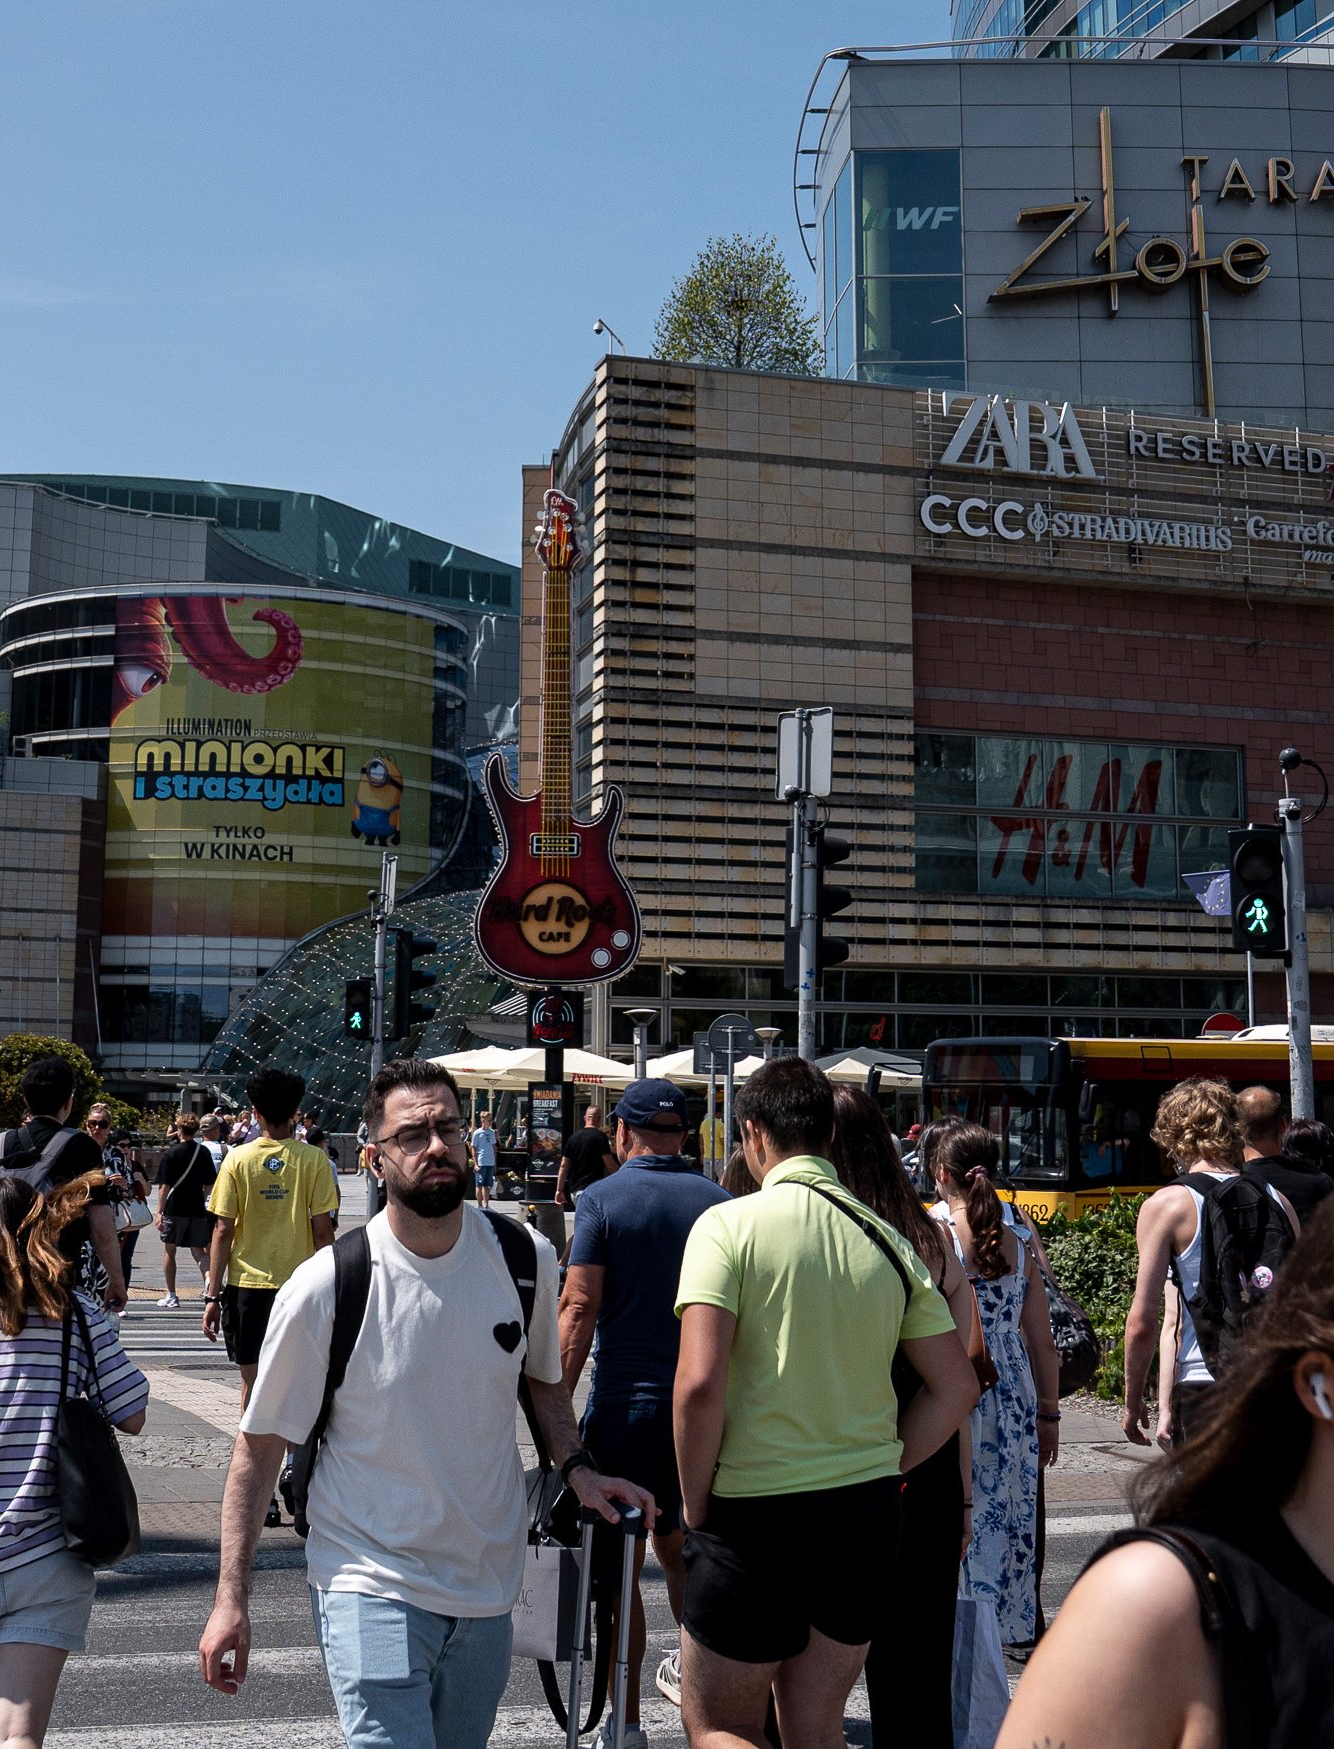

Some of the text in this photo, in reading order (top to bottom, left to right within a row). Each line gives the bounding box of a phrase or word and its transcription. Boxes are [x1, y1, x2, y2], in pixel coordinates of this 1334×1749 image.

[940, 391, 1105, 480] ZARA
[1129, 429, 1327, 474] RESERVED
[920, 494, 1026, 541] CCC
[1052, 511, 1233, 552] STRADIVARIUS
[166, 717, 317, 740] ILLUMINATION PRZEDSTAWIA
[155, 774, 343, 810] straszydła
[213, 825, 266, 839] TYLKO
[990, 753, 1163, 889] H&M
[184, 842, 294, 862] W KINACH
[538, 931, 571, 943] CAFE
